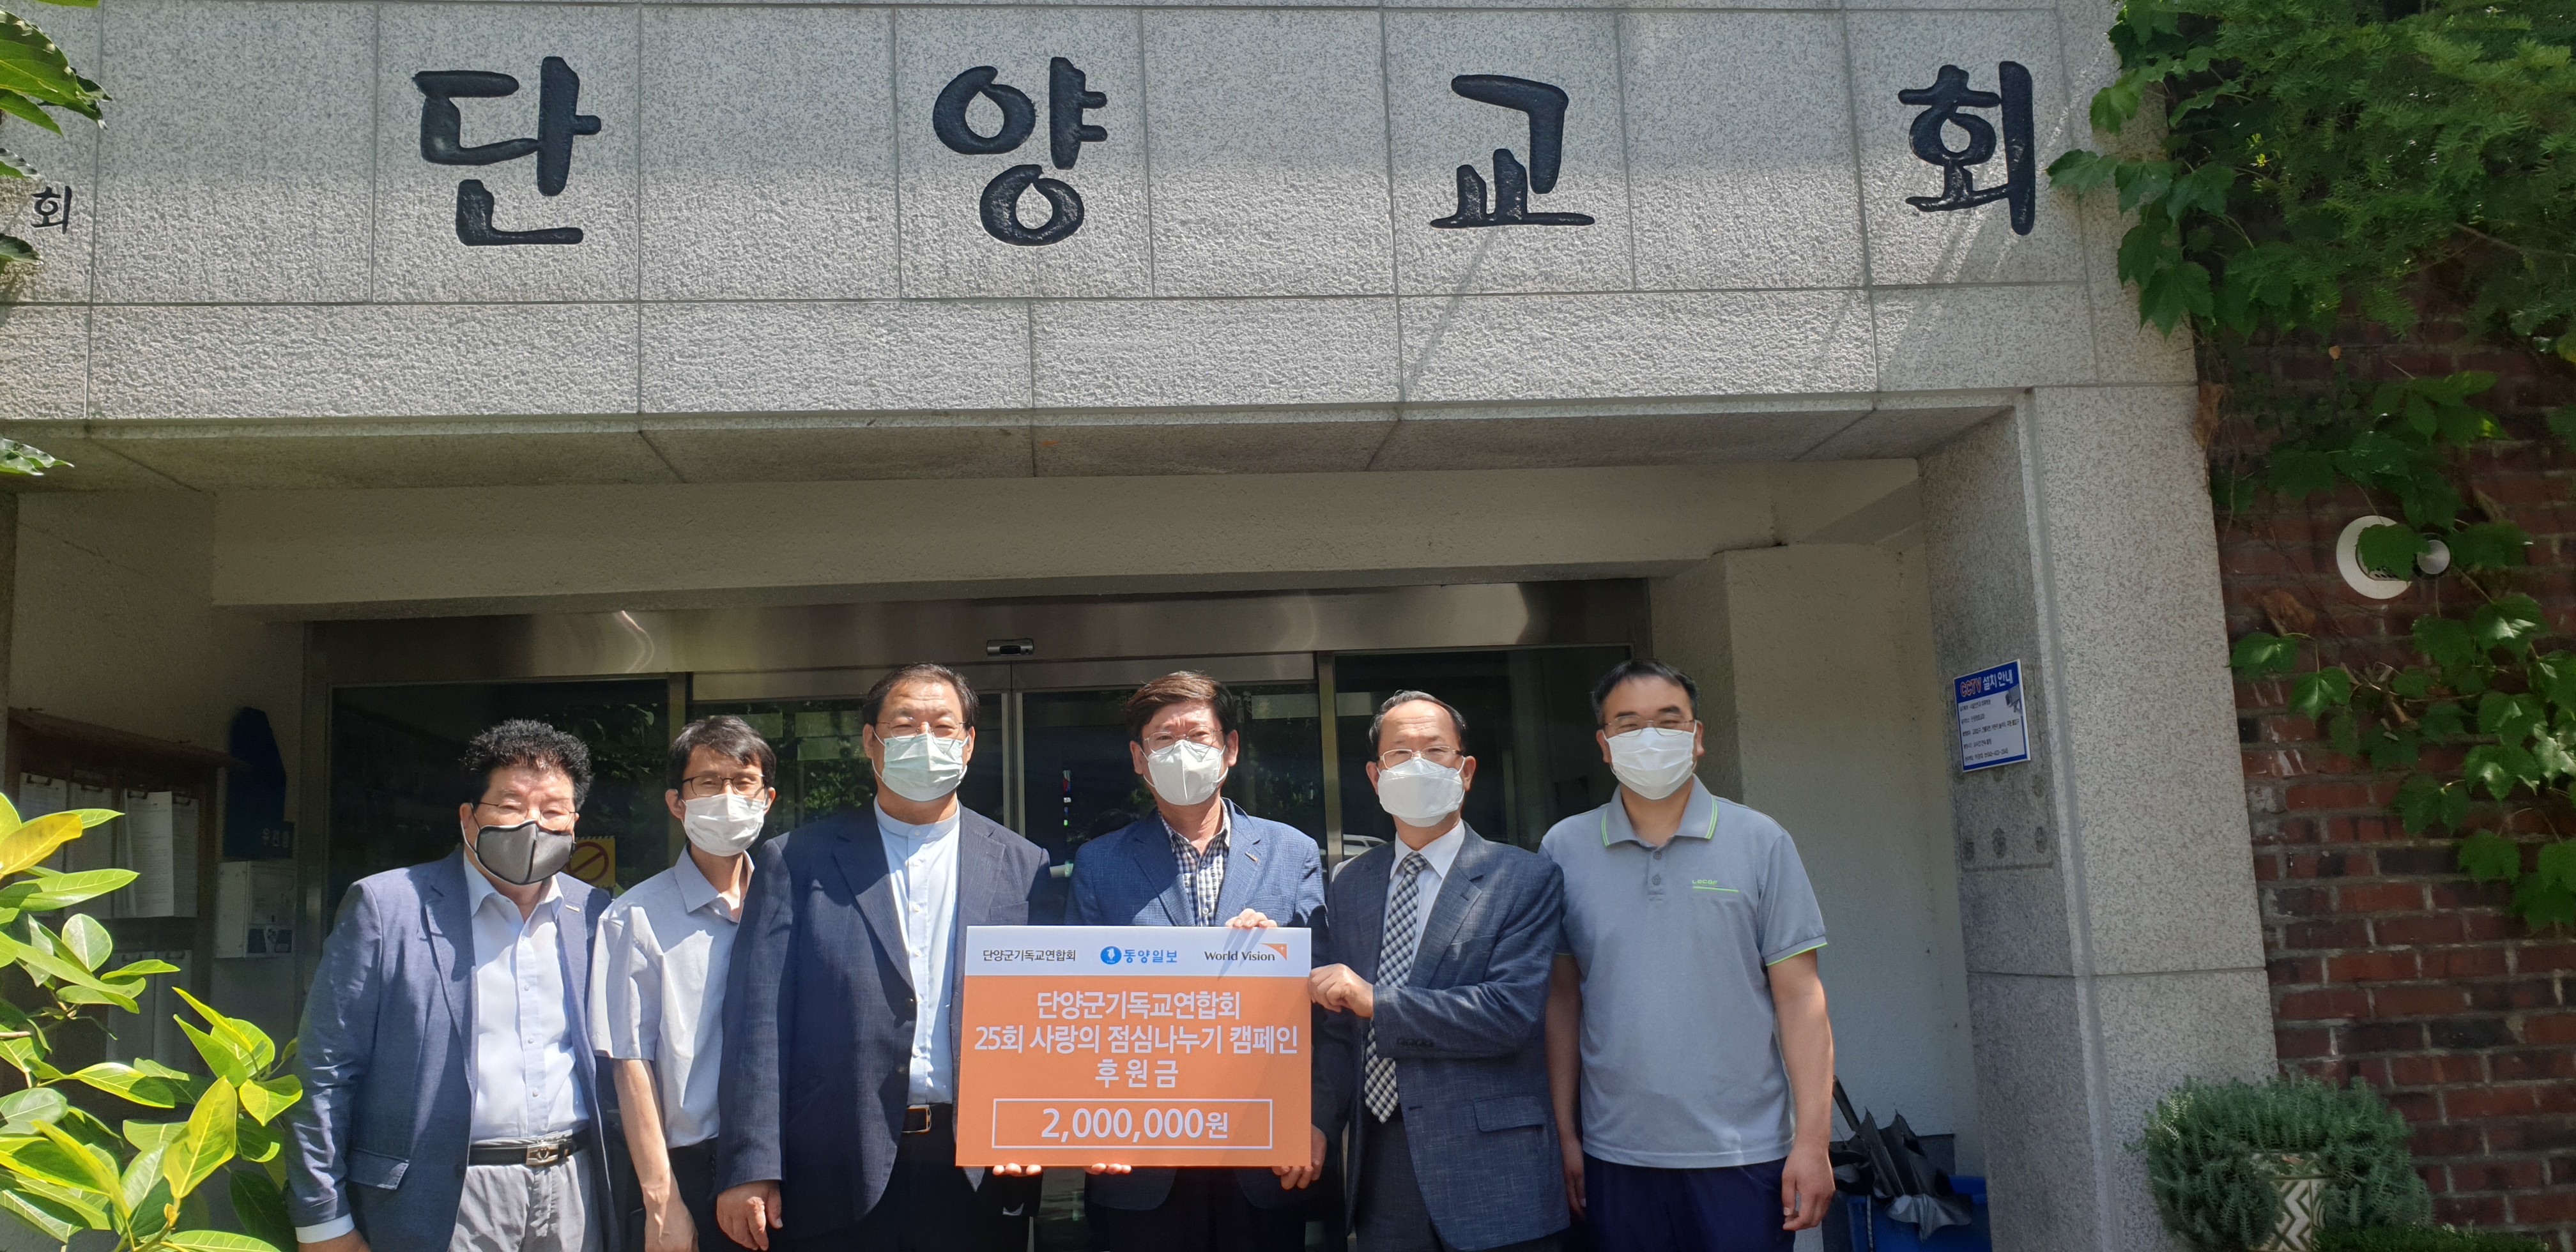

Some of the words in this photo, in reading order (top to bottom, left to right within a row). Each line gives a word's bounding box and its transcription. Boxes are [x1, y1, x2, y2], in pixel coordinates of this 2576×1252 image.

[31, 185, 72, 234] 회
[1960, 677, 1982, 698] CCTV
[1982, 673, 1997, 691] 설치
[1997, 669, 2013, 687] 안내
[983, 949, 1076, 962] 단양군기독교연합회
[1123, 949, 1177, 963] 동양일보
[1204, 950, 1238, 961] World
[1241, 950, 1275, 961] Vision
[1037, 991, 1240, 1019] 단양군기독교연합회
[974, 1025, 1023, 1053] 25회
[1029, 1025, 1100, 1054] 사랑의
[1107, 1025, 1222, 1054] 점심나누기
[1229, 1025, 1298, 1054] 캠페인
[1041, 1108, 1228, 1143] 2,000,000원
